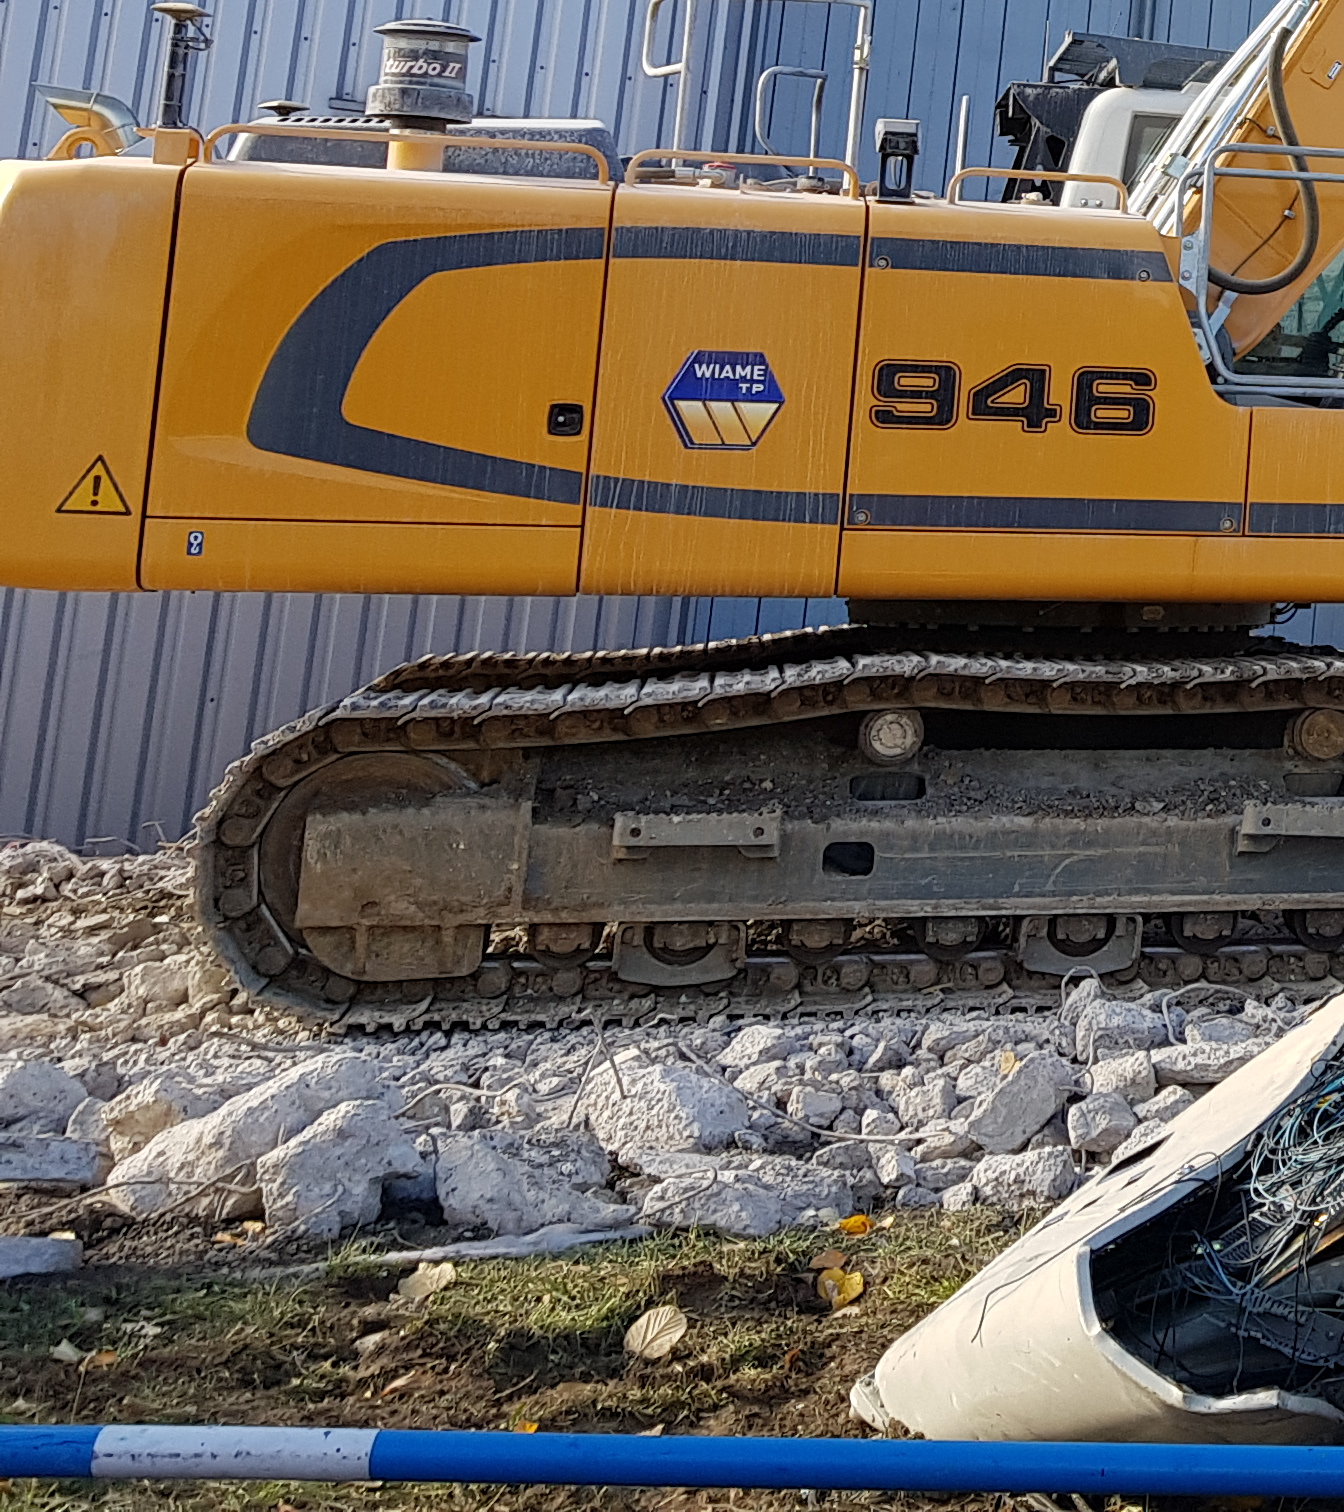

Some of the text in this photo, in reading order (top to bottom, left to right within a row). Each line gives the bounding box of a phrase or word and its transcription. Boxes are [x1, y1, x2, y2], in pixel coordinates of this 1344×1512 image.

[384, 57, 441, 76] turbo
[694, 363, 766, 381] WIAME
[738, 383, 765, 394] TP
[869, 359, 1157, 436] 946
